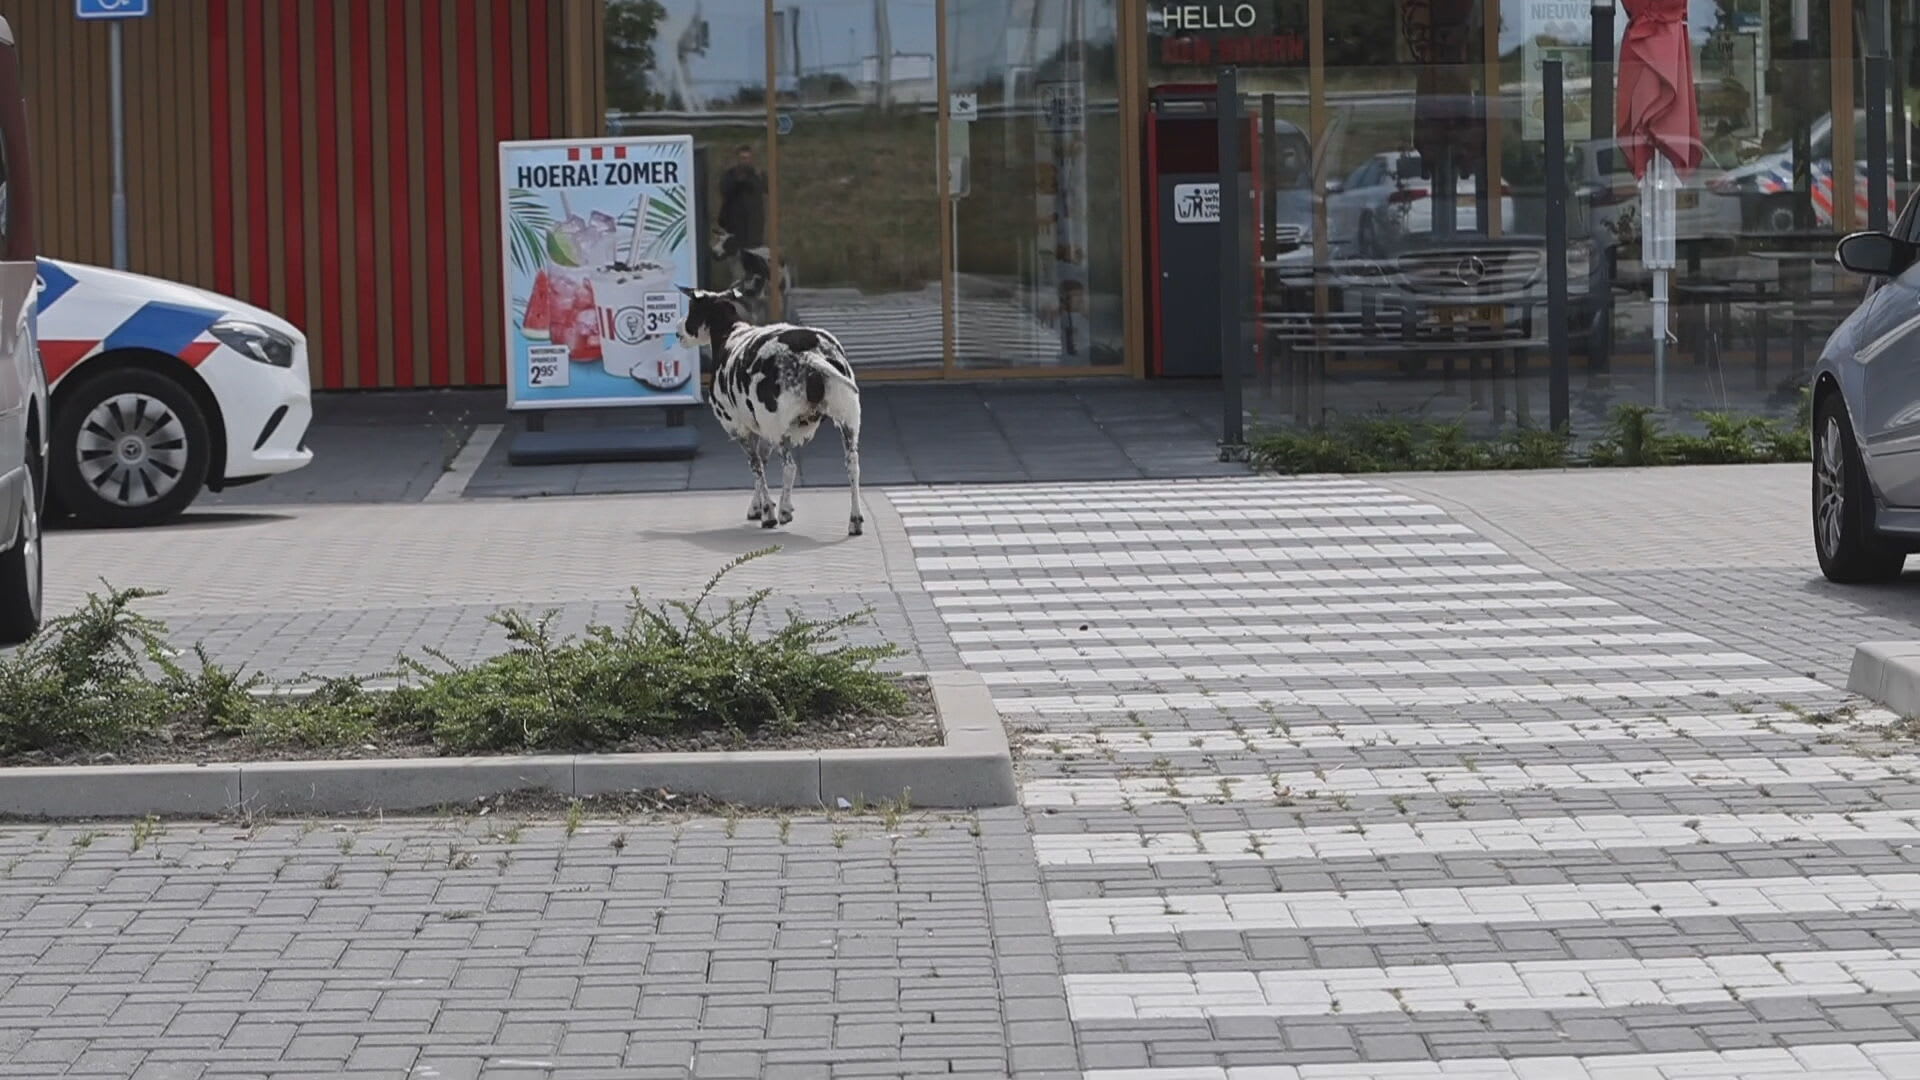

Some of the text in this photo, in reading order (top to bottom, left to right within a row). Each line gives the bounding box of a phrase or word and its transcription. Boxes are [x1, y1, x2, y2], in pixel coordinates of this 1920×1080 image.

[1162, 4, 1256, 29] HELLO
[1530, 3, 1578, 20] NIEUW
[518, 161, 679, 188] HOERA! ZOMER
